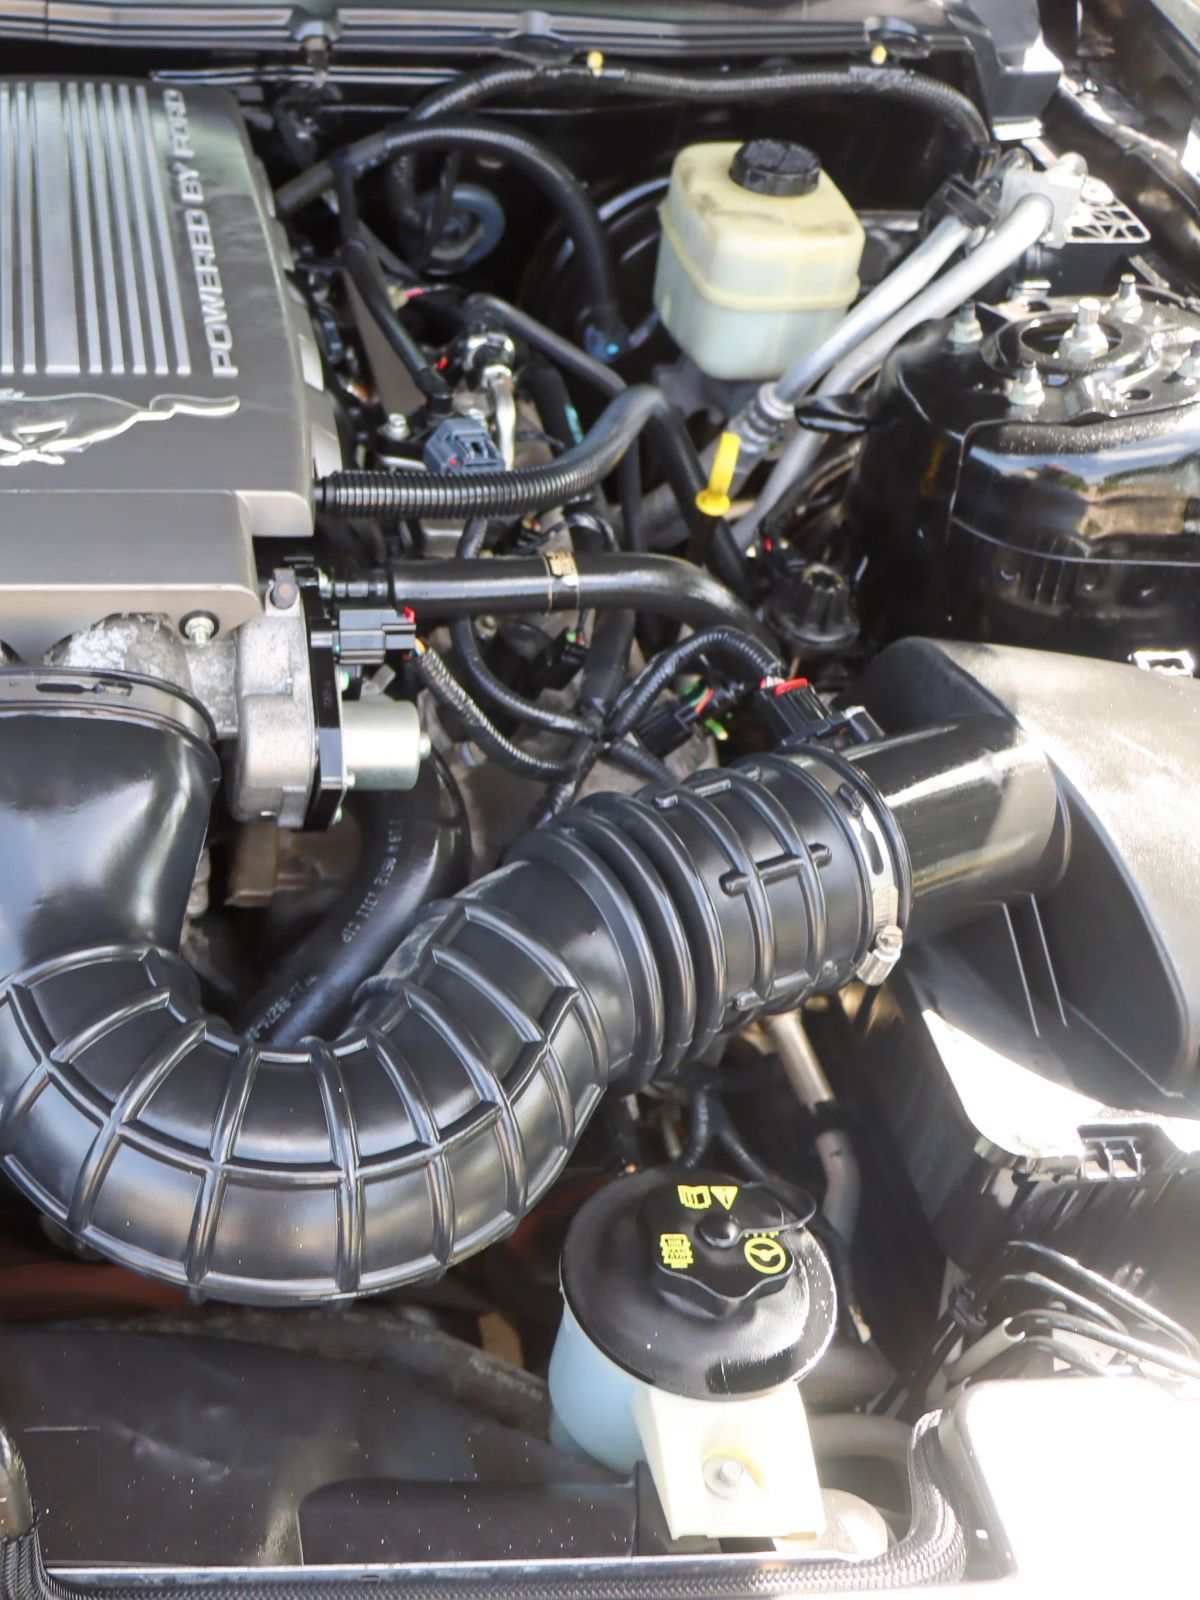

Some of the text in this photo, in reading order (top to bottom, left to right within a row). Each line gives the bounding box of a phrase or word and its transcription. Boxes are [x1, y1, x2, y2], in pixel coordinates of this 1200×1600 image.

[163, 88, 238, 377] POWERED BY FORD
